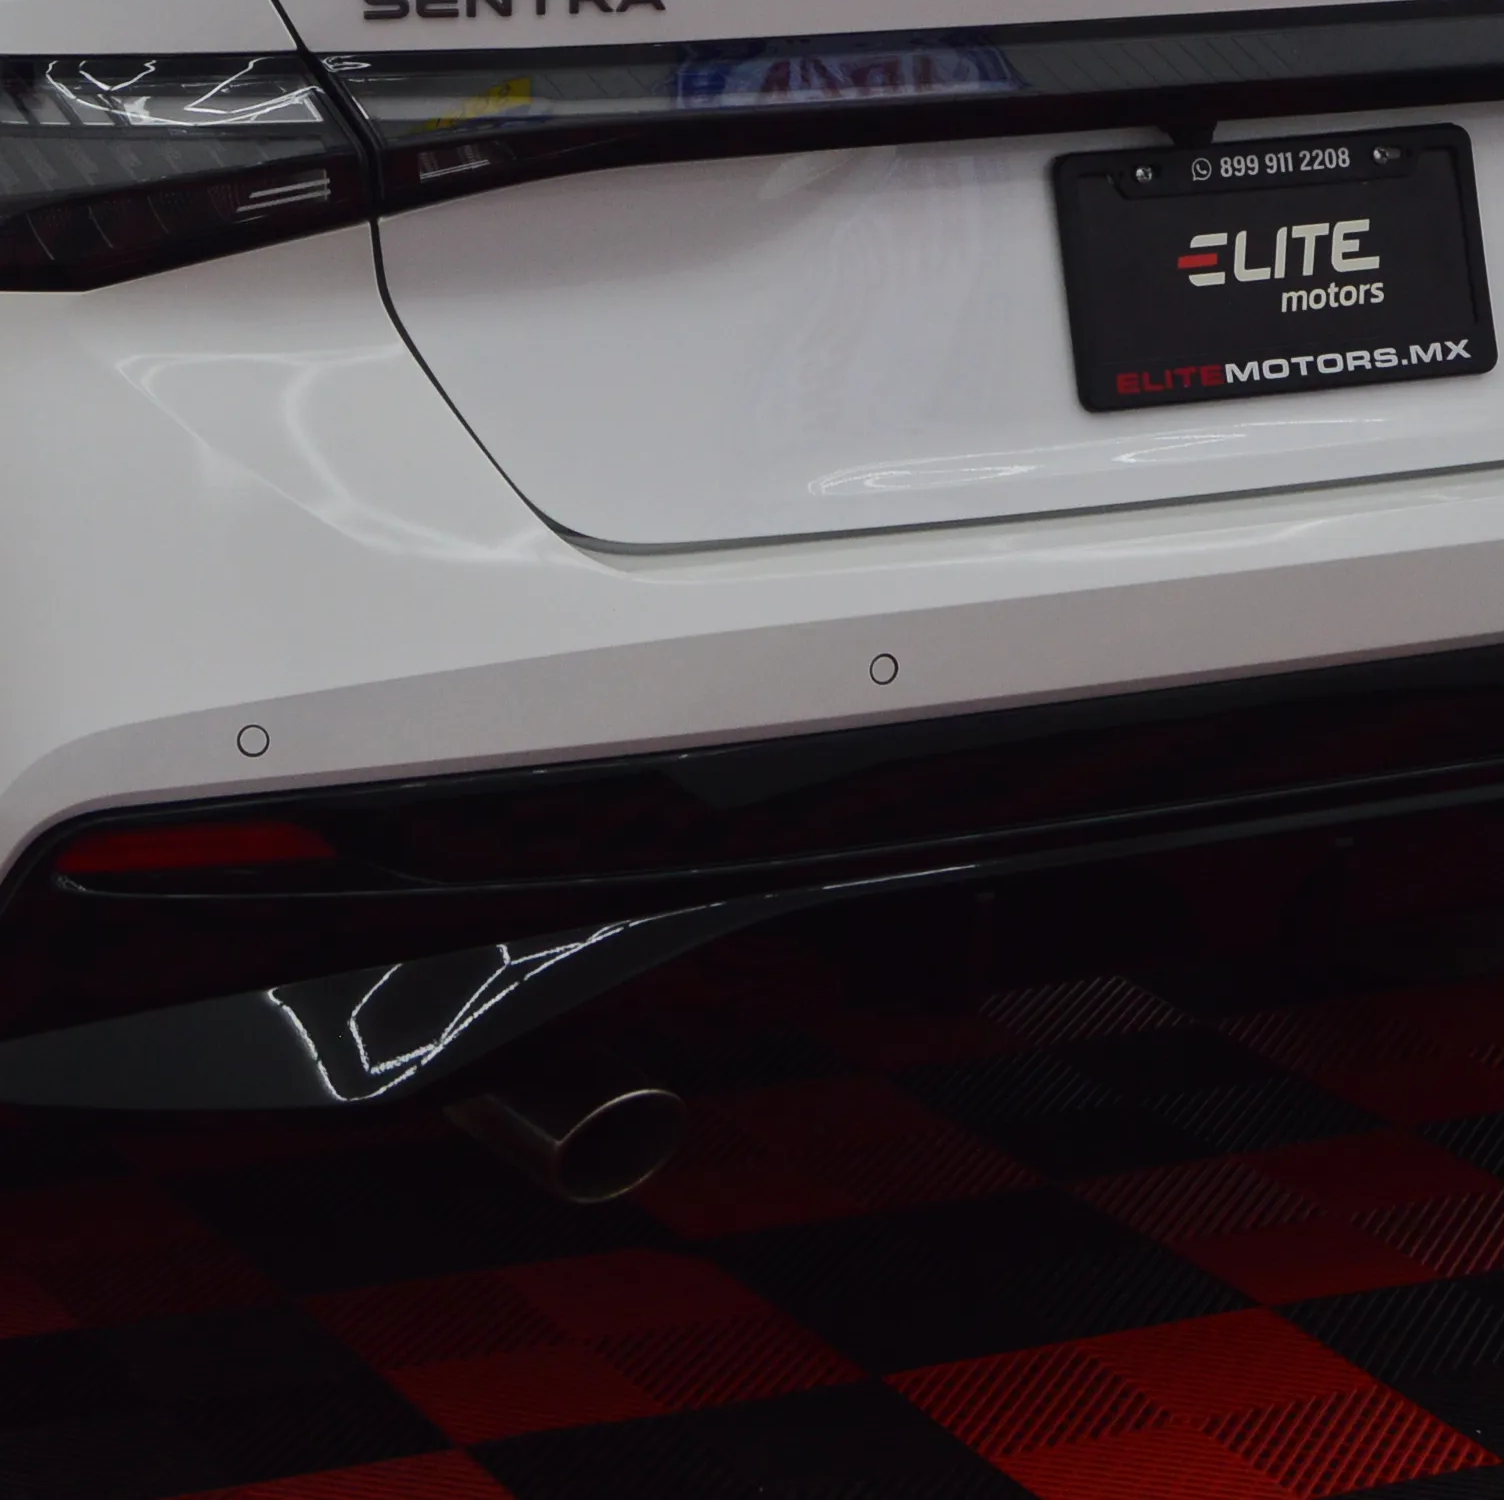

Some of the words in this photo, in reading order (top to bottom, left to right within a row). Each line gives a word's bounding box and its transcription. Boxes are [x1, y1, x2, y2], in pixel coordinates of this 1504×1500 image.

[1220, 154, 1259, 178] 899
[1264, 151, 1294, 174] 911
[1298, 146, 1351, 171] 2208
[1177, 218, 1381, 287] ELITE
[1280, 281, 1385, 313] motors
[1116, 338, 1472, 395] ELITEMOTORS.MX
